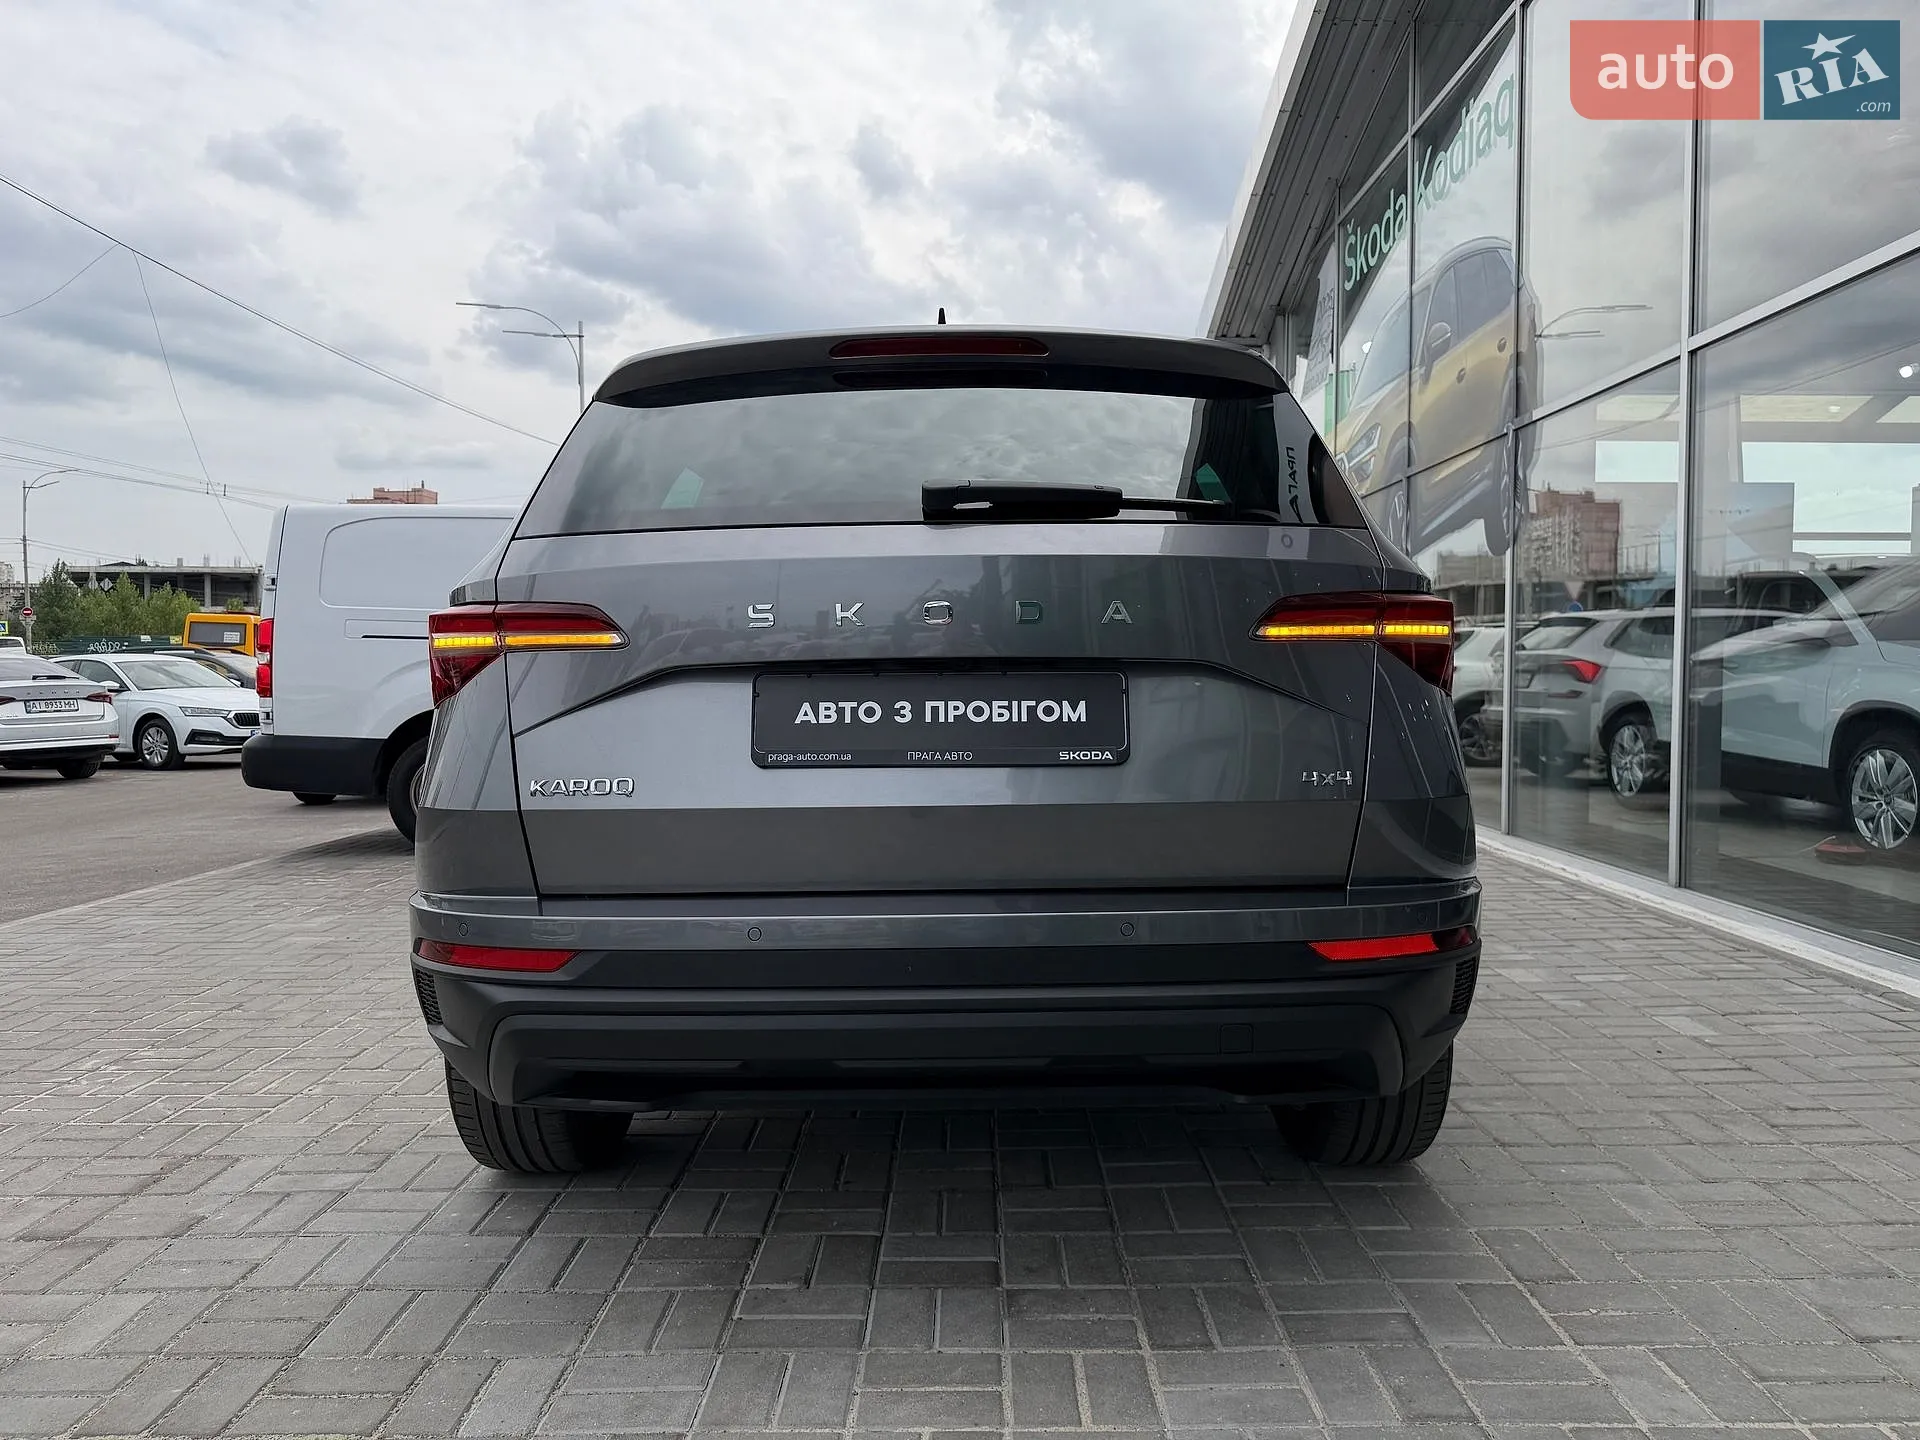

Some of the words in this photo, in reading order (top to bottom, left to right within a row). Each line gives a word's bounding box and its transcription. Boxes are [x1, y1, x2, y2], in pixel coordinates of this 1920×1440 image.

[1344, 188, 1408, 291] Škoda
[1414, 73, 1514, 212] Kodiaq
[747, 600, 1133, 628] SKODA
[794, 701, 882, 724] АВТО
[925, 700, 1087, 723] ПРОБІГОМ
[768, 752, 852, 762] praga-auto.com.ua
[907, 752, 942, 761] ПРАГА
[943, 751, 973, 761] АВТО
[1059, 751, 1114, 760] SKODA
[530, 777, 635, 797] KAROQ
